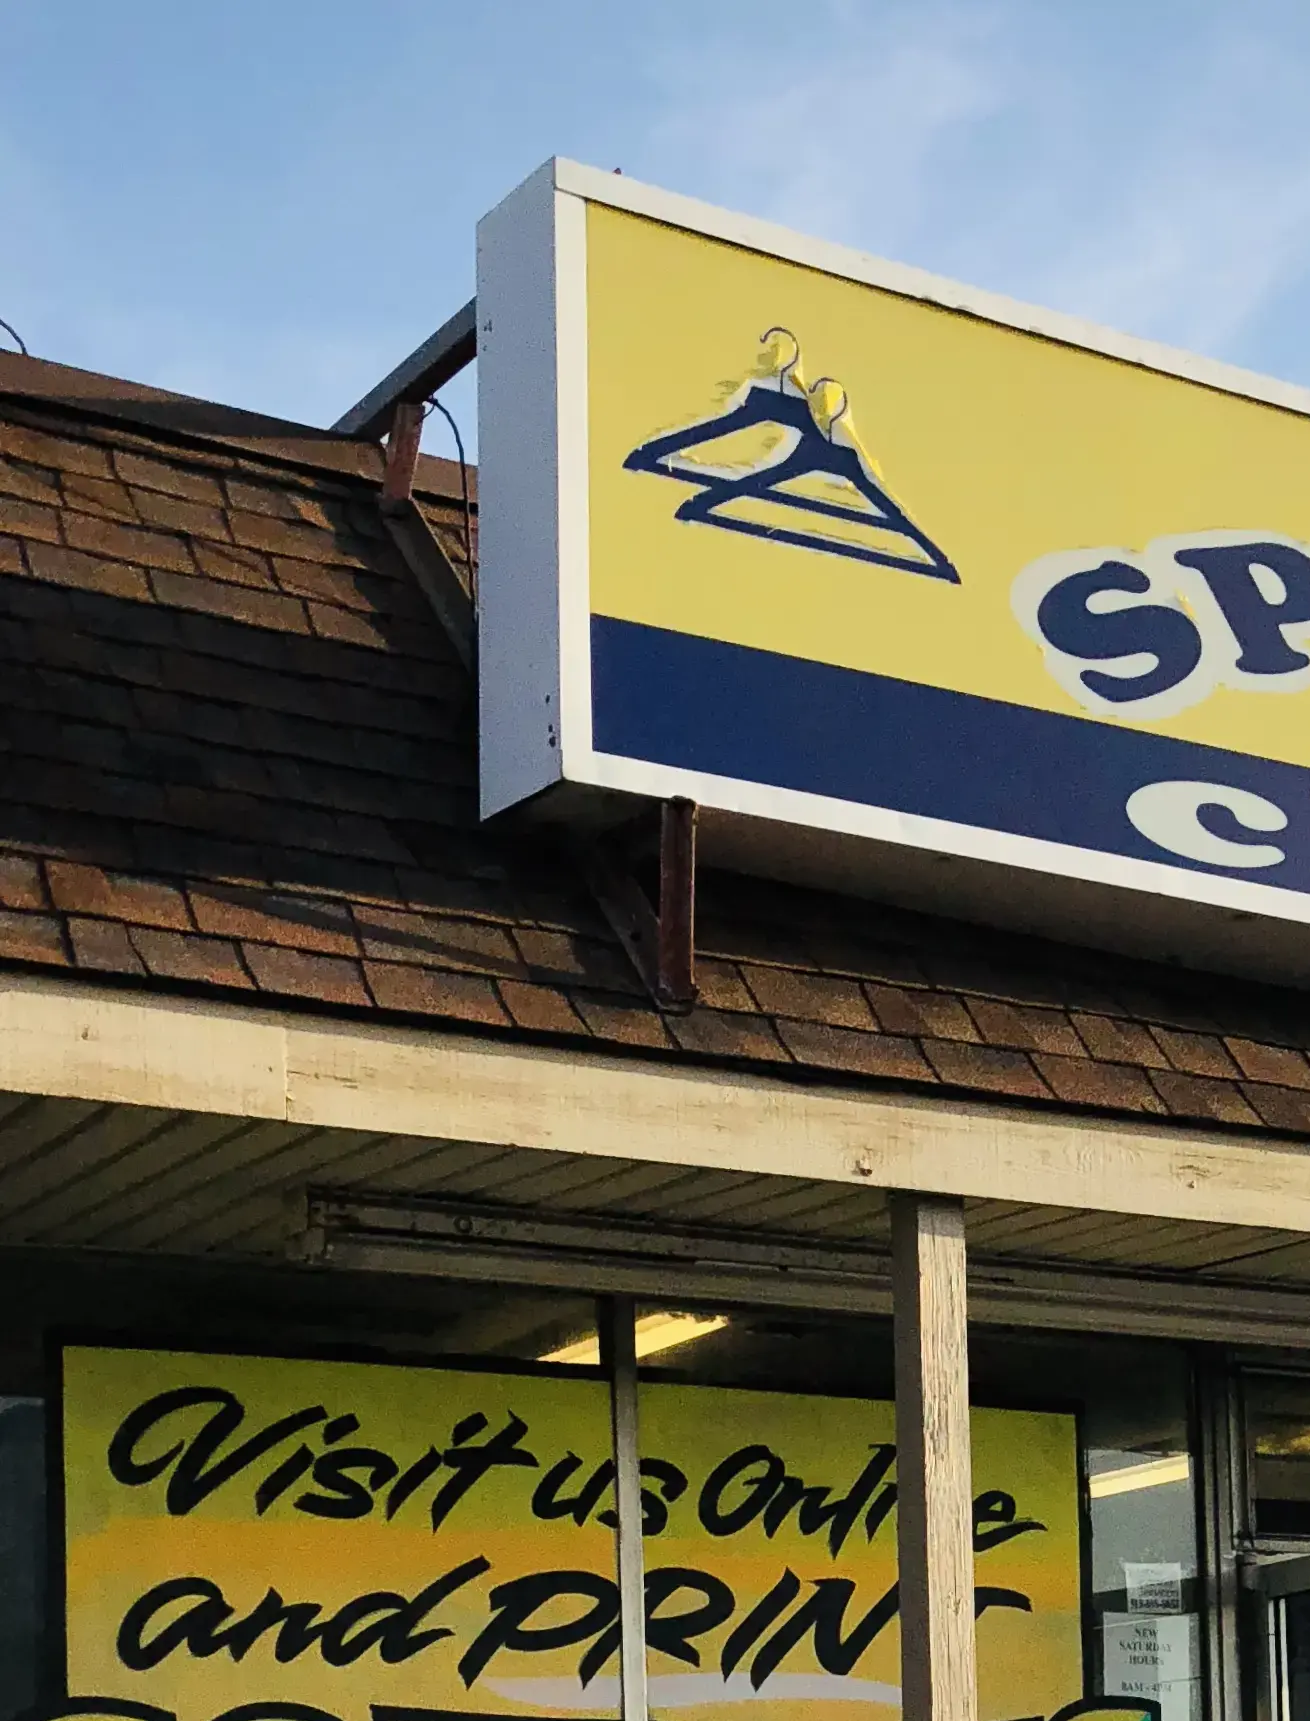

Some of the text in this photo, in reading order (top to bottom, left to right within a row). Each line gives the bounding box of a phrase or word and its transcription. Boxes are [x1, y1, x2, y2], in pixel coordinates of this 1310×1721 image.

[107, 1385, 1048, 1561] Visit us Onlie
[117, 1554, 491, 1672] and
[1134, 1628, 1159, 1638] NEW
